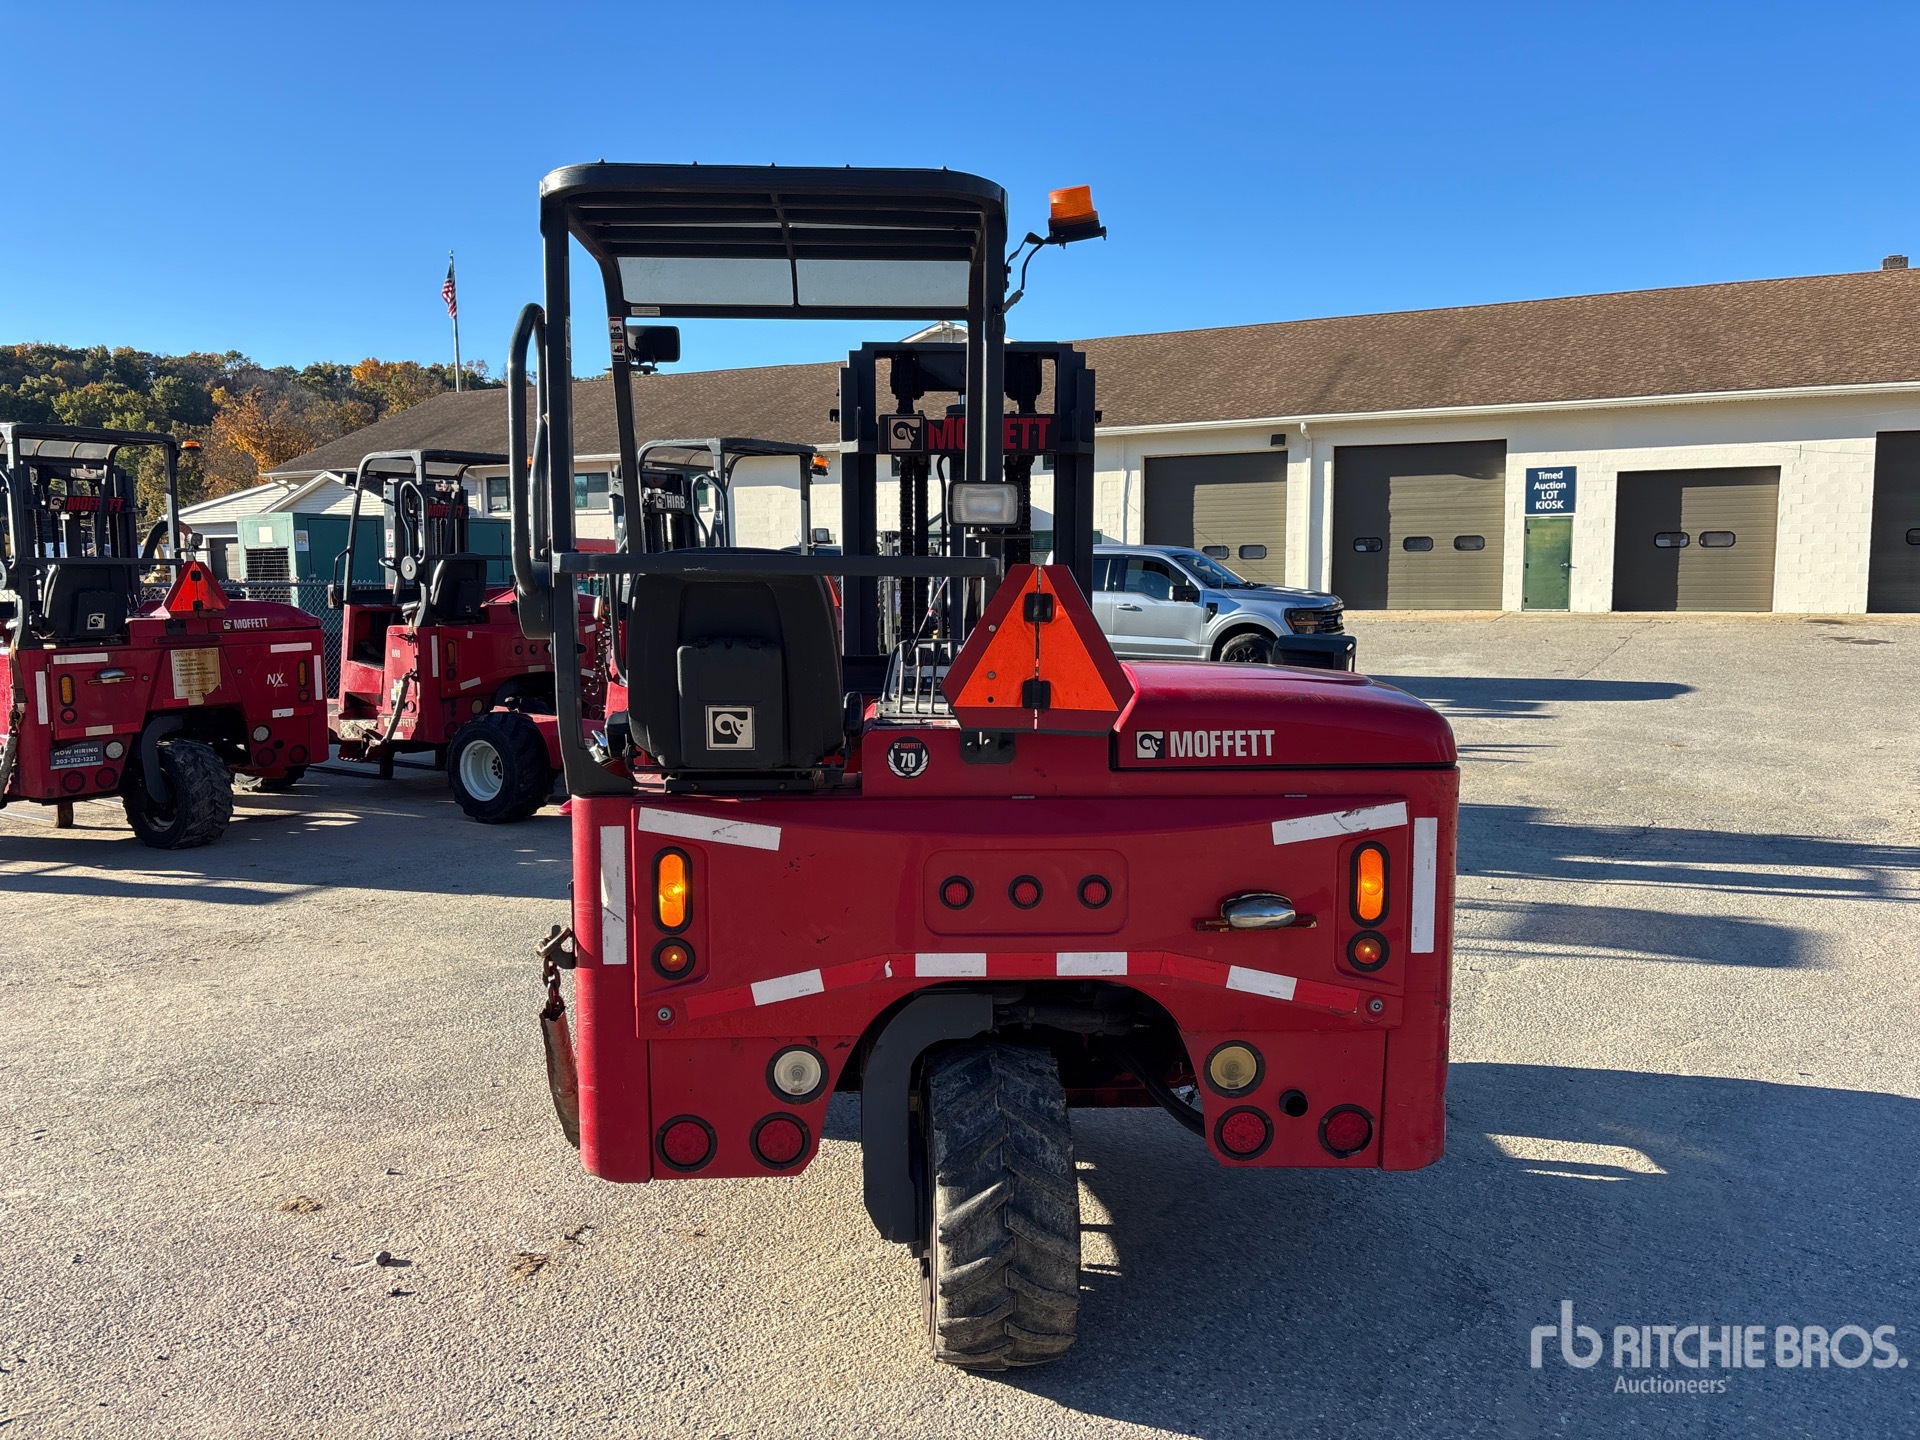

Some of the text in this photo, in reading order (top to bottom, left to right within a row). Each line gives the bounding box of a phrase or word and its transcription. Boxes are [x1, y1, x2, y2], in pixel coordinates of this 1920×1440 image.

[928, 417, 1051, 450] MOETT
[1537, 470, 1564, 480] Timed
[1533, 481, 1567, 490] Auction
[1541, 490, 1559, 500] LOT
[1535, 500, 1565, 510] KIOSK
[233, 617, 268, 630] MOFFETT
[266, 672, 285, 688] NX
[1169, 729, 1276, 758] MOFFETT
[54, 749, 72, 757] NOW
[73, 747, 99, 755] HIRING
[55, 756, 97, 765] 203-312-1221
[900, 752, 916, 768] 70
